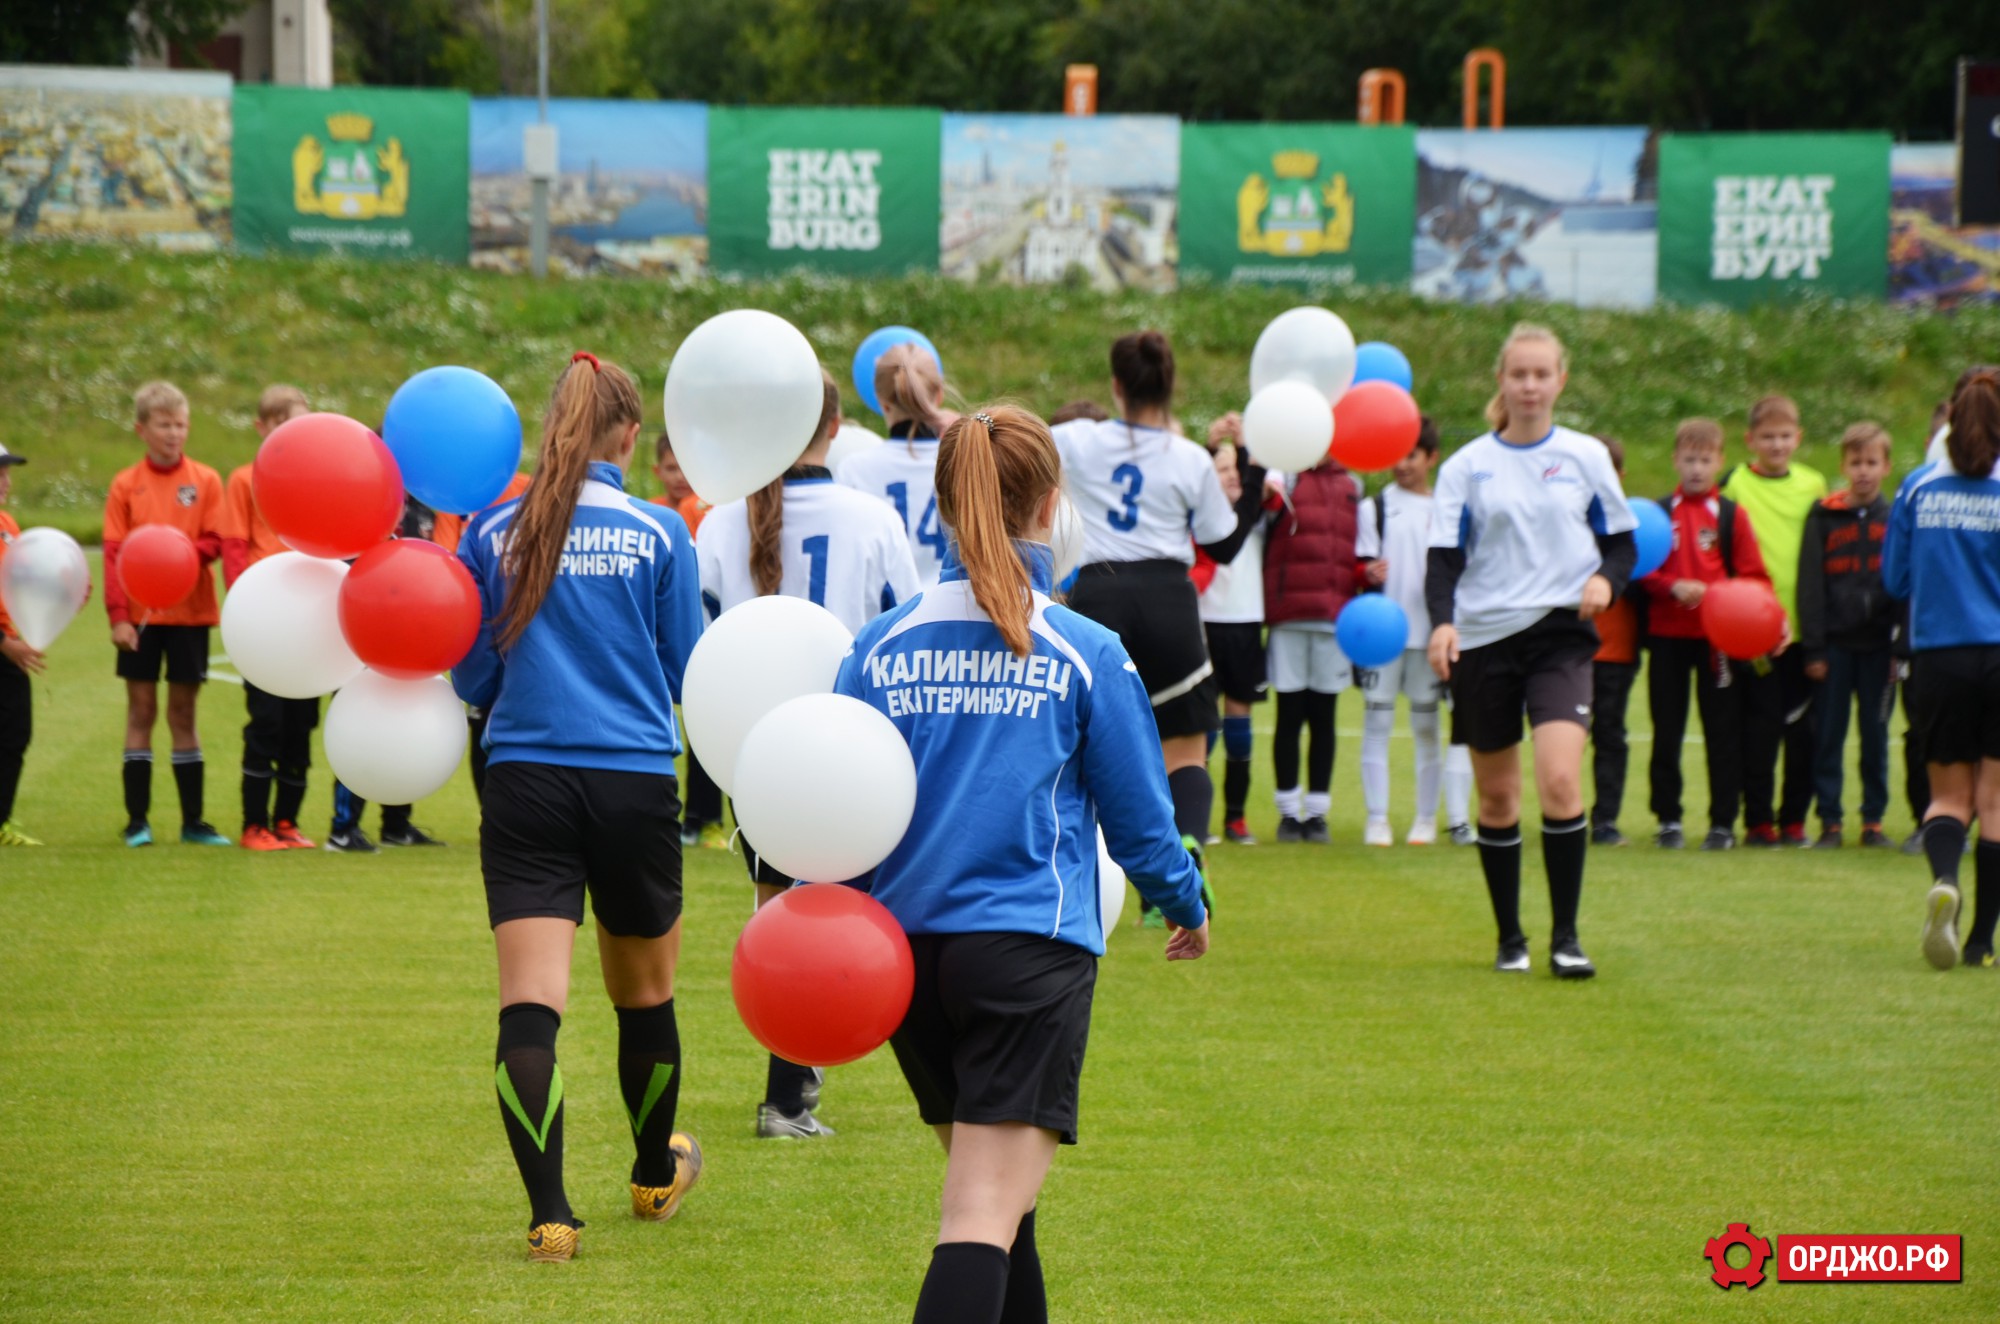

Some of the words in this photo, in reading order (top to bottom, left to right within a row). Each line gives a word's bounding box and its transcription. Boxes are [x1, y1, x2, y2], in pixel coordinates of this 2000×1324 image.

[768, 149, 881, 183] EKAT
[768, 184, 881, 216] ERIN
[1715, 175, 1835, 211] ЕКАТ
[767, 218, 881, 250] BURG
[1713, 212, 1832, 246] ЕРИН
[1711, 247, 1832, 279] БУРГ
[1108, 463, 1143, 532] 3
[802, 535, 828, 608] 1
[871, 649, 1072, 702] КАЛИНИНЕЦ
[886, 685, 1048, 719] ЕКАТЕРИНБУРГ
